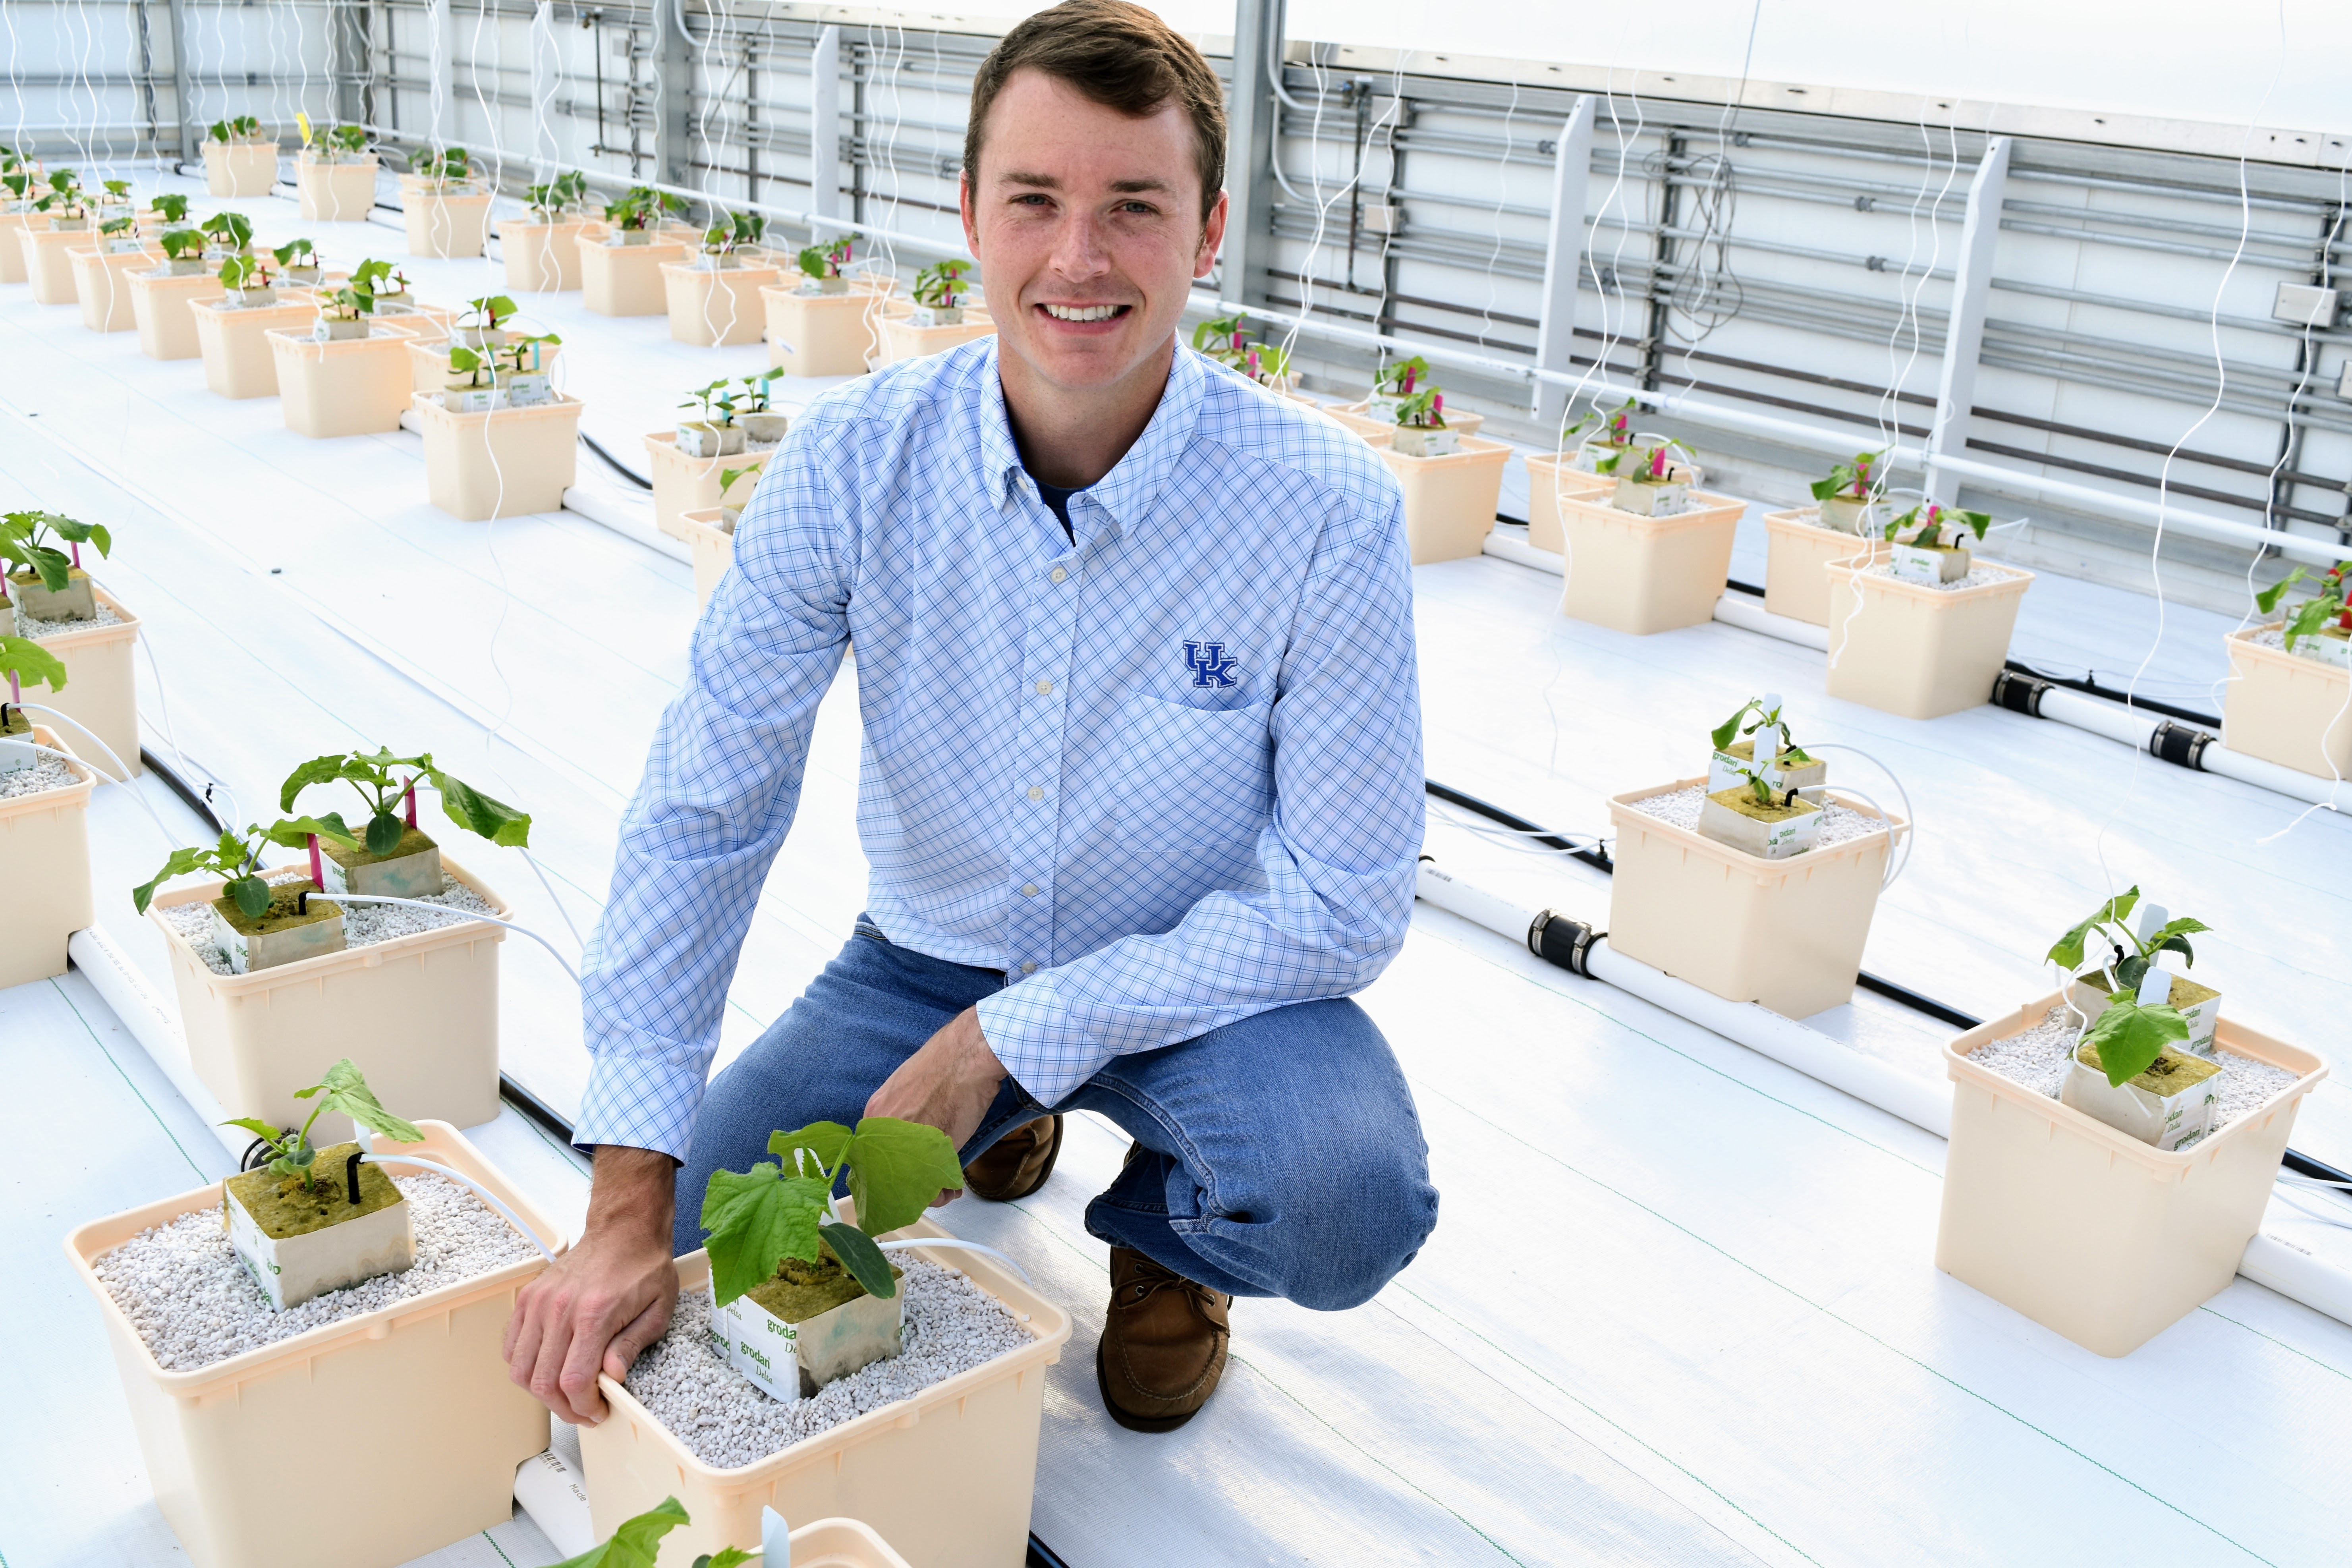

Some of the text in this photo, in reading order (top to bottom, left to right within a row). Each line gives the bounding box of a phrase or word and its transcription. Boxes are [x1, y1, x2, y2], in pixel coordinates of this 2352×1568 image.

[1183, 640, 1238, 688] UK
[1713, 751, 1737, 767] grodan
[2174, 1129, 2200, 1151] grodan
[741, 1341, 770, 1369] grodan
[756, 1365, 772, 1385] Delta
[569, 1483, 587, 1501] Made
